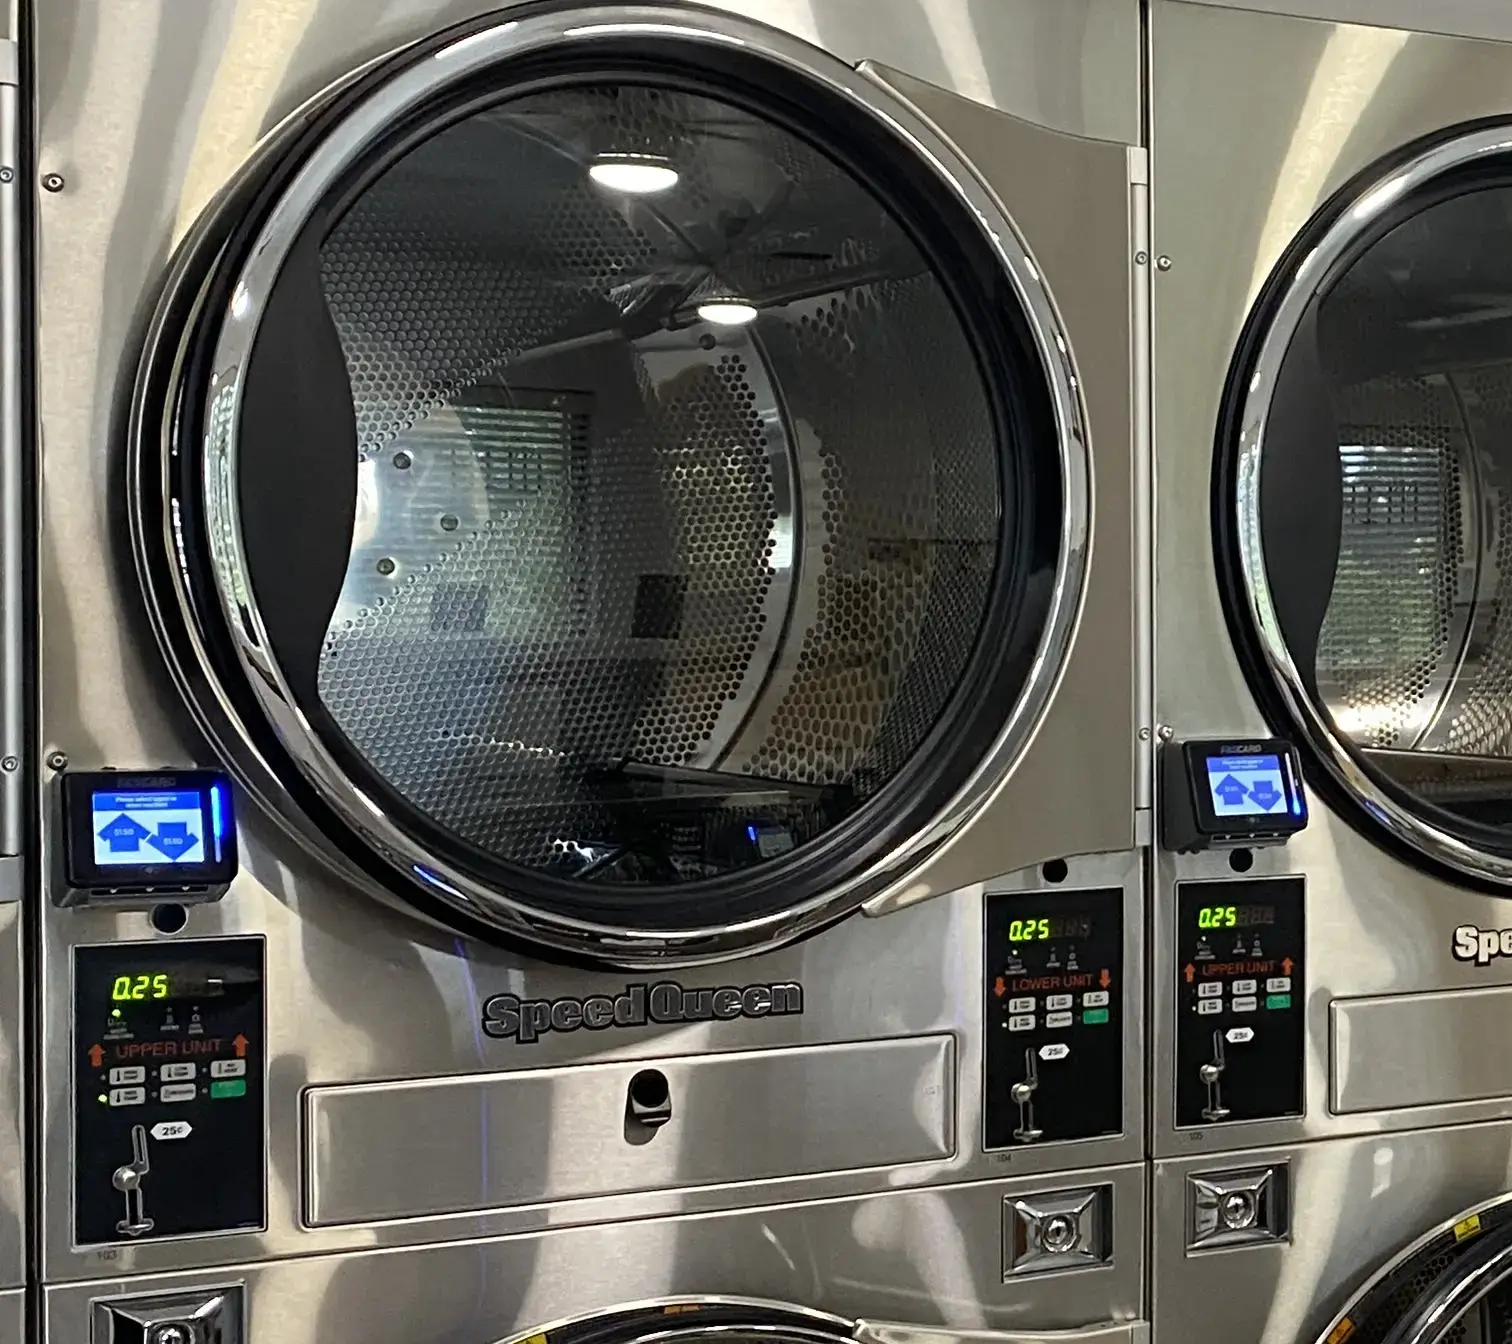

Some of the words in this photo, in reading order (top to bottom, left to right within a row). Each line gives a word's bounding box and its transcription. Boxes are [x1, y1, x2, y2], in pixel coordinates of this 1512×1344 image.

[1202, 962, 1245, 977] UPPER
[1246, 959, 1277, 974] UNIT
[1011, 976, 1060, 993] LOWER
[1063, 973, 1094, 988] UNIT
[482, 982, 649, 1044] Speed
[649, 980, 804, 1022] Queen
[115, 1041, 178, 1058] UPPER
[181, 1038, 223, 1055] UNIT
